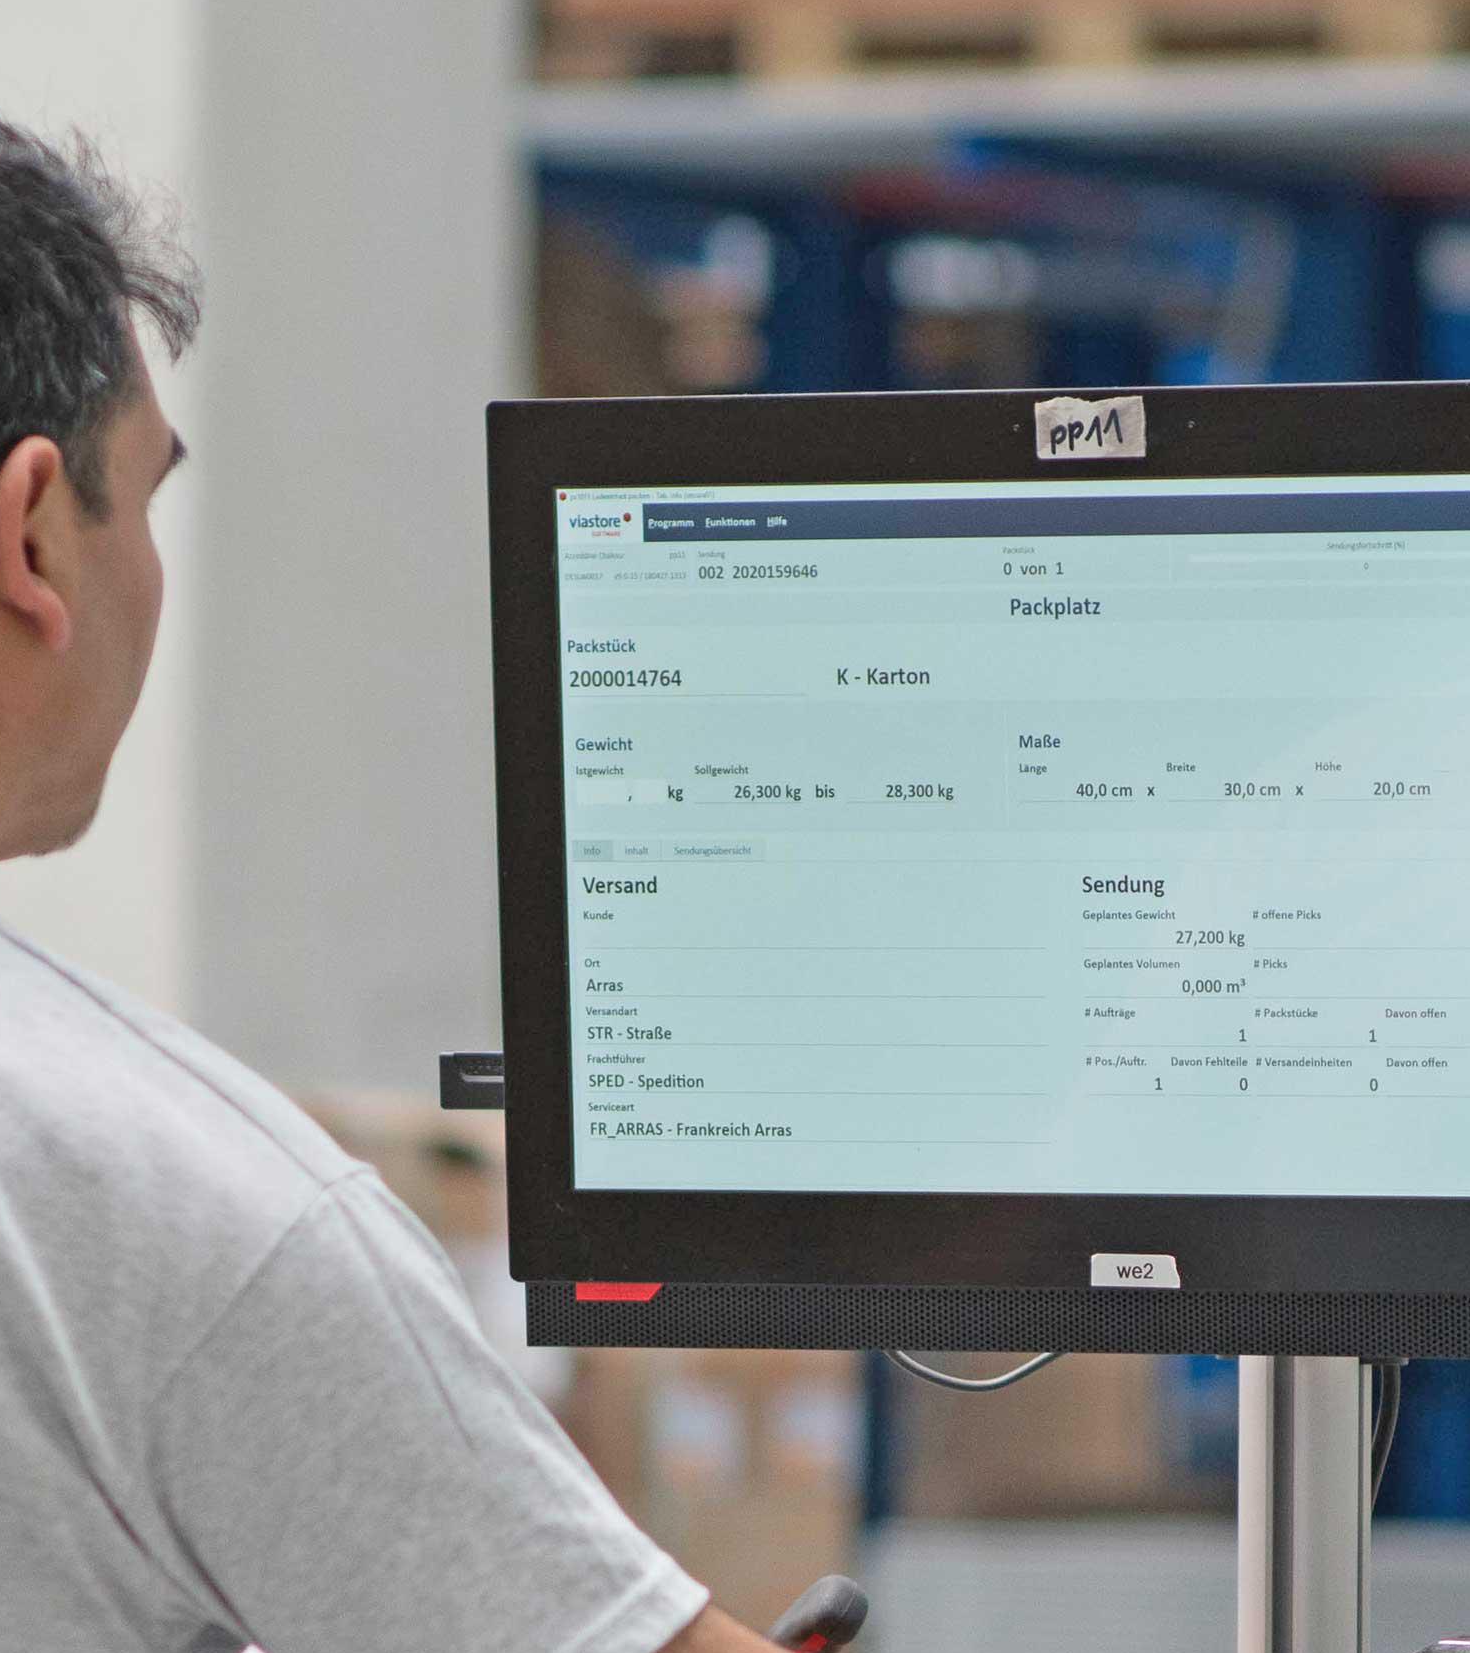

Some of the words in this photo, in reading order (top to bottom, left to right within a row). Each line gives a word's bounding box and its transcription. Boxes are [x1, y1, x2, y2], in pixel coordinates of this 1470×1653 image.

[1050, 409, 1123, 455] pp11
[569, 514, 621, 528] viastore
[648, 518, 694, 529] Programm
[705, 518, 756, 528] Funktionen
[767, 516, 787, 527] Hilfe
[699, 566, 724, 579] 002
[733, 565, 817, 579] 2020159646
[1004, 563, 1012, 575] 0
[1020, 565, 1046, 575] von
[1056, 562, 1063, 575] 1
[1011, 597, 1100, 619] Packplatz
[568, 639, 636, 652] Packstück
[570, 670, 682, 687] 2000014764
[838, 669, 848, 685] K
[868, 668, 929, 685] Karton
[576, 737, 633, 751] Gewicht
[1020, 734, 1060, 748] Maße
[695, 765, 748, 777] Sollgewicht
[1167, 763, 1195, 772] Breite
[1315, 762, 1341, 771] Höhe
[668, 786, 683, 802] kg
[735, 785, 781, 801] 26,300
[786, 785, 801, 801] kg
[816, 785, 834, 798] bis
[886, 785, 933, 800] 28,300
[938, 784, 953, 800] kg
[1076, 784, 1107, 799] 40,0
[1112, 787, 1132, 796] cm
[1148, 787, 1154, 796] x
[1225, 783, 1255, 798] 30,0
[1260, 786, 1280, 796] cm
[1296, 786, 1303, 795] x
[1374, 782, 1404, 798] 20,0
[1409, 785, 1430, 795] cm
[674, 846, 751, 857] Sendungsübersicht
[583, 876, 657, 893] Versand
[1083, 875, 1164, 897] Sendung
[584, 910, 614, 920] Kunde
[1083, 910, 1132, 922] Geplantes
[1135, 910, 1175, 919] Gewicht
[1262, 910, 1293, 919] offene
[1297, 910, 1321, 919] Picks
[1177, 931, 1224, 946] 27,200
[1229, 931, 1245, 947] kg
[585, 959, 600, 967] Ort
[1084, 959, 1133, 970] Geplantes
[1136, 959, 1180, 968] Volumen
[1263, 959, 1287, 968] Picks
[587, 979, 623, 991] Arras
[1182, 980, 1221, 995] 0,000
[586, 1006, 637, 1016] Versandart
[1094, 1007, 1135, 1019] Aufträge
[1264, 1008, 1318, 1018] Packstücke
[1386, 1009, 1417, 1018] Davon
[1420, 1008, 1446, 1018] offen
[588, 1027, 613, 1039] STR
[627, 1026, 671, 1039] Straße
[1239, 1029, 1246, 1042] 1
[1369, 1030, 1377, 1042] 1
[587, 1054, 645, 1064] Frachtführer
[1095, 1056, 1146, 1067] Pos./Auftr.
[1171, 1057, 1202, 1066] Davon
[1206, 1057, 1248, 1066] Fehlteile
[1265, 1057, 1352, 1067] Versandeinheiten
[1387, 1058, 1418, 1067] Davon
[1421, 1057, 1447, 1067] offen
[589, 1075, 624, 1087] SPED
[638, 1074, 704, 1090] Spedition
[1155, 1078, 1162, 1090] 1
[1240, 1078, 1248, 1091] 0
[1370, 1079, 1378, 1091] 0
[588, 1103, 634, 1111] Serviceart
[591, 1122, 663, 1138] FR_ARRAS
[677, 1123, 750, 1136] Frankreich
[755, 1123, 792, 1136] Arras
[1117, 1263, 1153, 1279] we2
